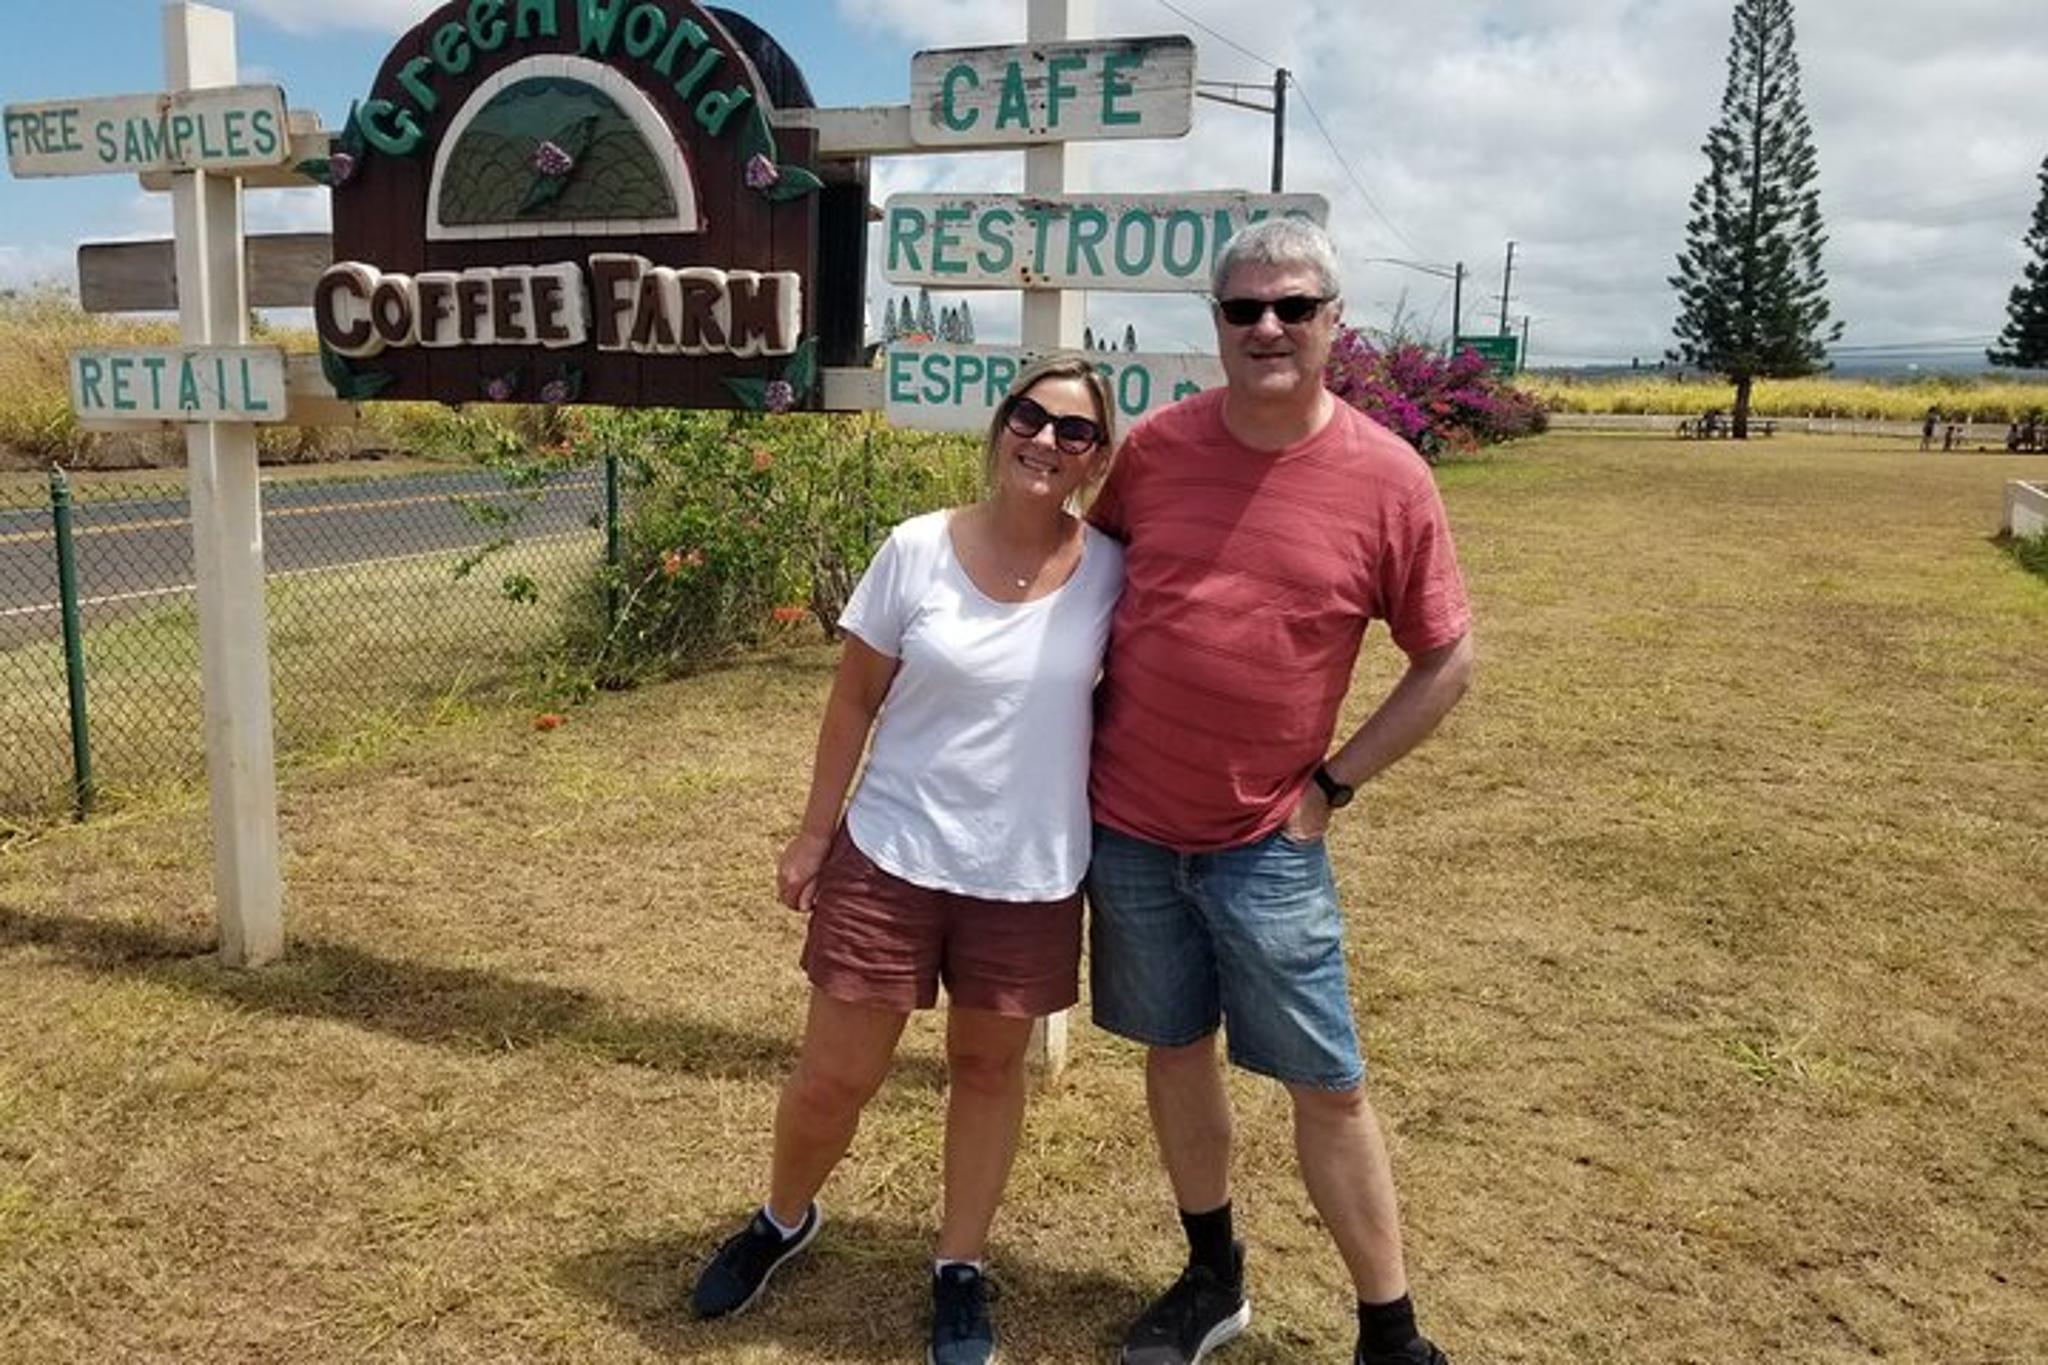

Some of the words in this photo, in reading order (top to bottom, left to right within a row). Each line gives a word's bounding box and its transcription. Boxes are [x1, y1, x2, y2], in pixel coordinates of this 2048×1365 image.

[355, 0, 559, 156] Green
[576, 0, 753, 137] World
[941, 49, 1143, 133] CAFE
[3, 107, 84, 157] FREE
[95, 109, 278, 165] SAMPLES
[886, 206, 1315, 278] RESTROO
[314, 262, 586, 357] COFFEE
[589, 253, 800, 356] FARM
[78, 356, 269, 411] RETAIL
[889, 352, 1151, 416] ESPRO
